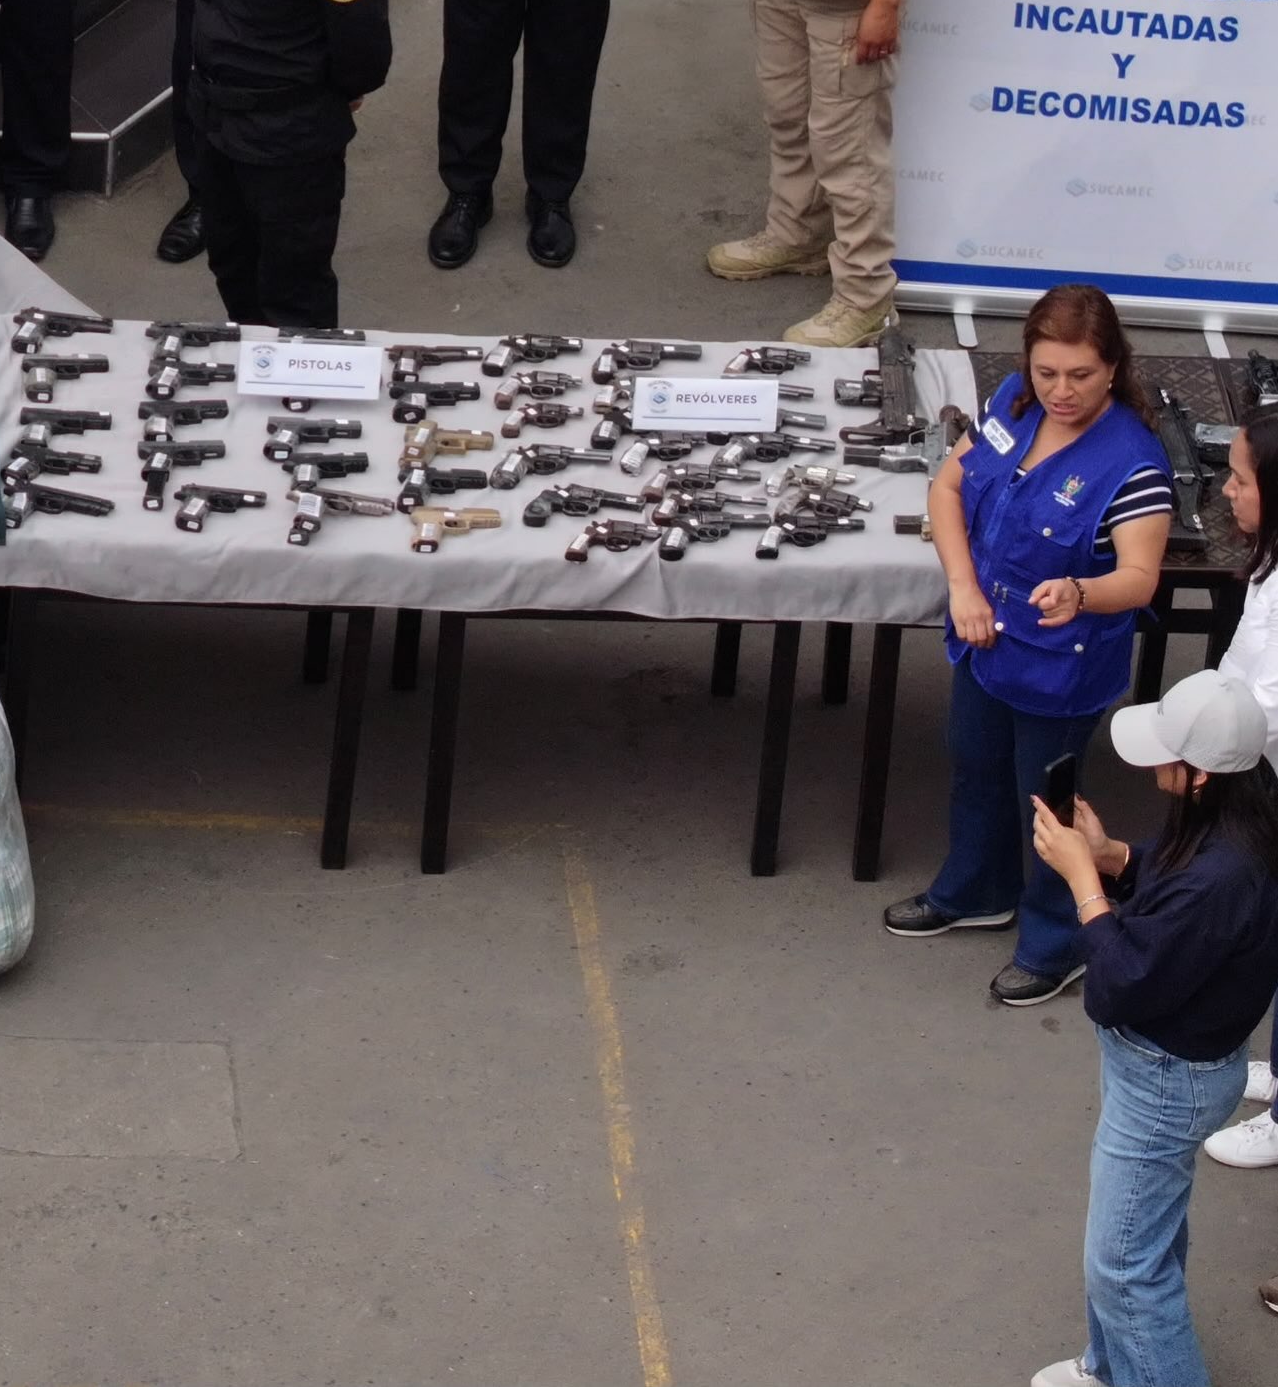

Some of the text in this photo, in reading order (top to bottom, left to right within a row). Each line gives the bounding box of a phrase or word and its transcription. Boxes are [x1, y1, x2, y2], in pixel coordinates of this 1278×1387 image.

[1013, 2, 1240, 44] INCAUTADAS
[1111, 53, 1135, 80] Y
[990, 86, 1247, 129] DECOMISADAS
[1089, 181, 1156, 199] SUCAMEC
[979, 244, 1045, 260] SUCAMEC
[1188, 257, 1253, 273] SUCAMEC
[287, 357, 353, 374] PISTOLAS
[675, 389, 759, 406] REVÓLVERES
